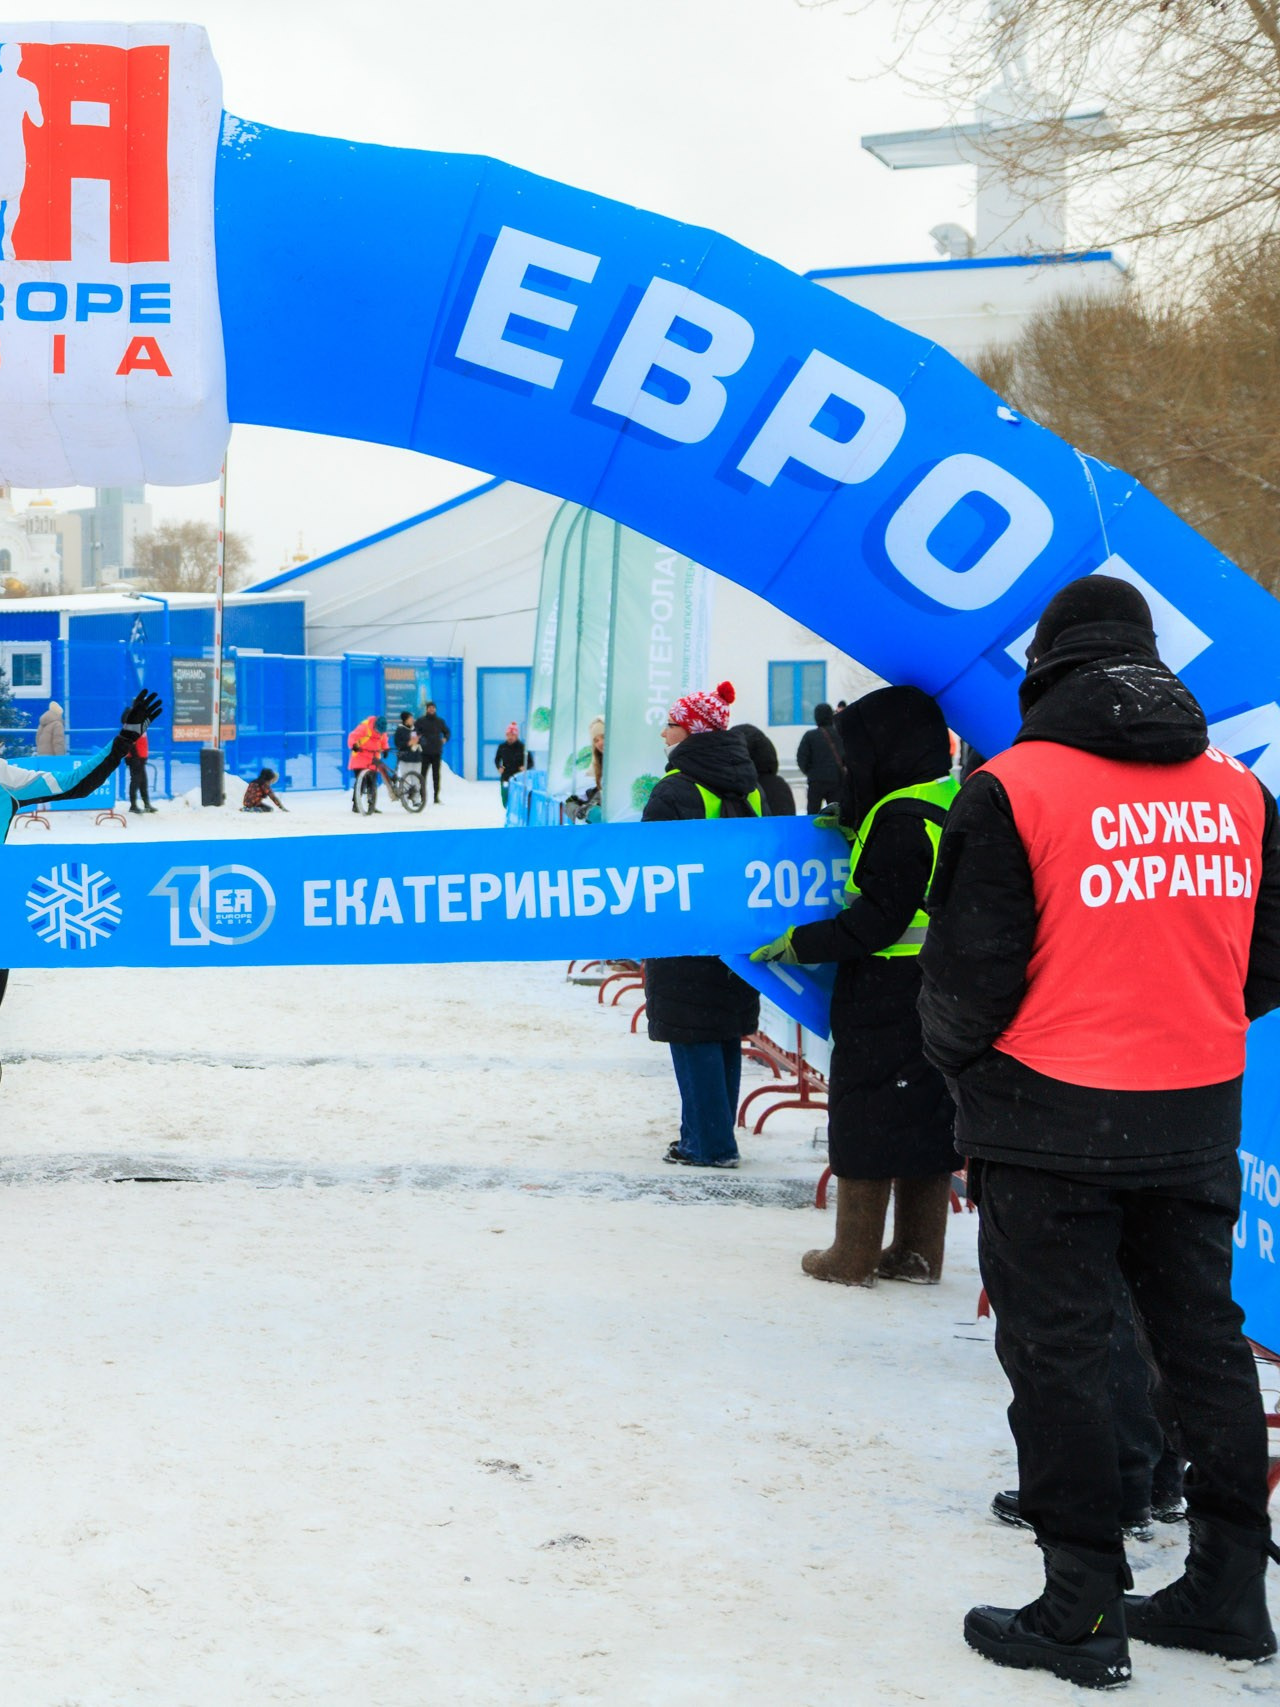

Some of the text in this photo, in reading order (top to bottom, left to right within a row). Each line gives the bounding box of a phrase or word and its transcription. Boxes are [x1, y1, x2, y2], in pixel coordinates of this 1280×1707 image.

[645, 546, 679, 726] ЭНТЕРОЛА
[1091, 801, 1240, 850] СЛУЖБА
[303, 864, 704, 927] ЕКАТЕРИНБУРГ
[744, 858, 850, 909] 2025
[1080, 854, 1252, 908] ОХРАНЫ
